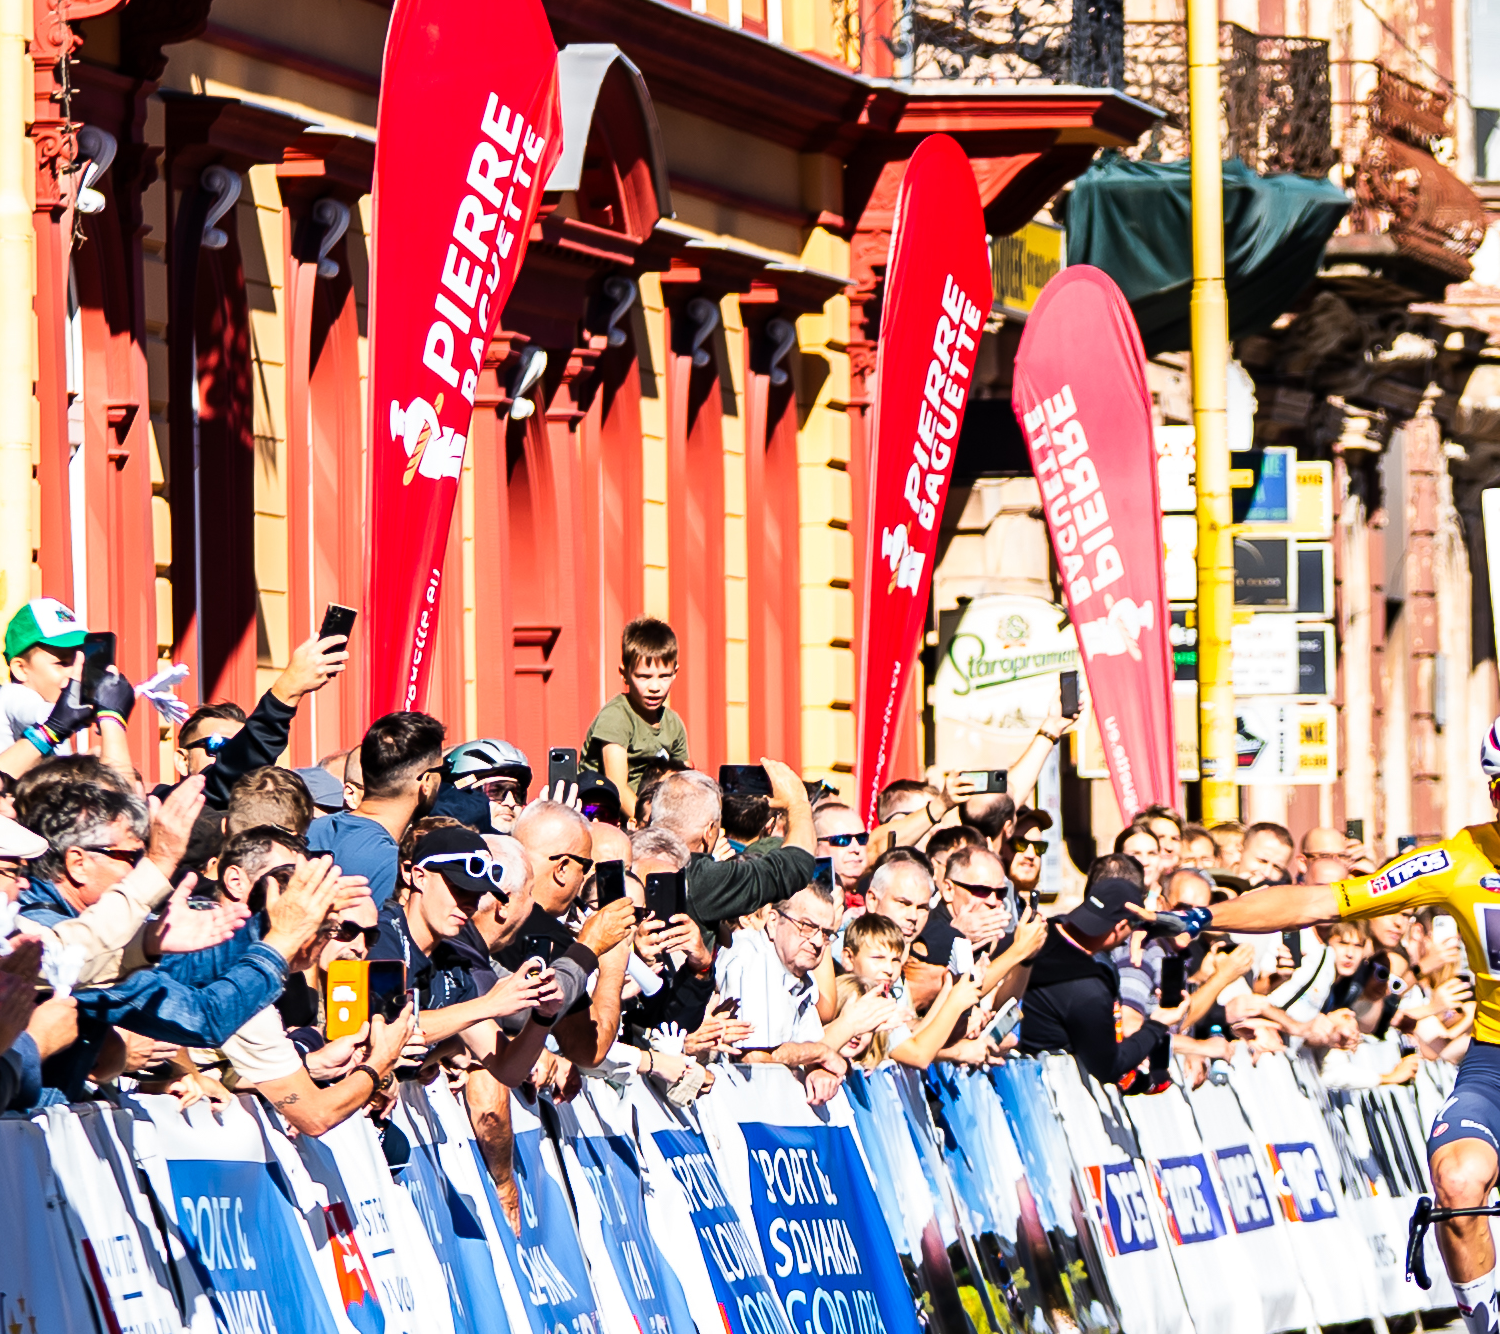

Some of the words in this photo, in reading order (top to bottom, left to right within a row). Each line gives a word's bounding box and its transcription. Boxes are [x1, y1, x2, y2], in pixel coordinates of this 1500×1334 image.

[422, 91, 525, 389] PIERRE
[903, 273, 968, 519] PIERRE
[917, 298, 982, 533] BAGUETTE
[1389, 850, 1448, 884] TIPOS
